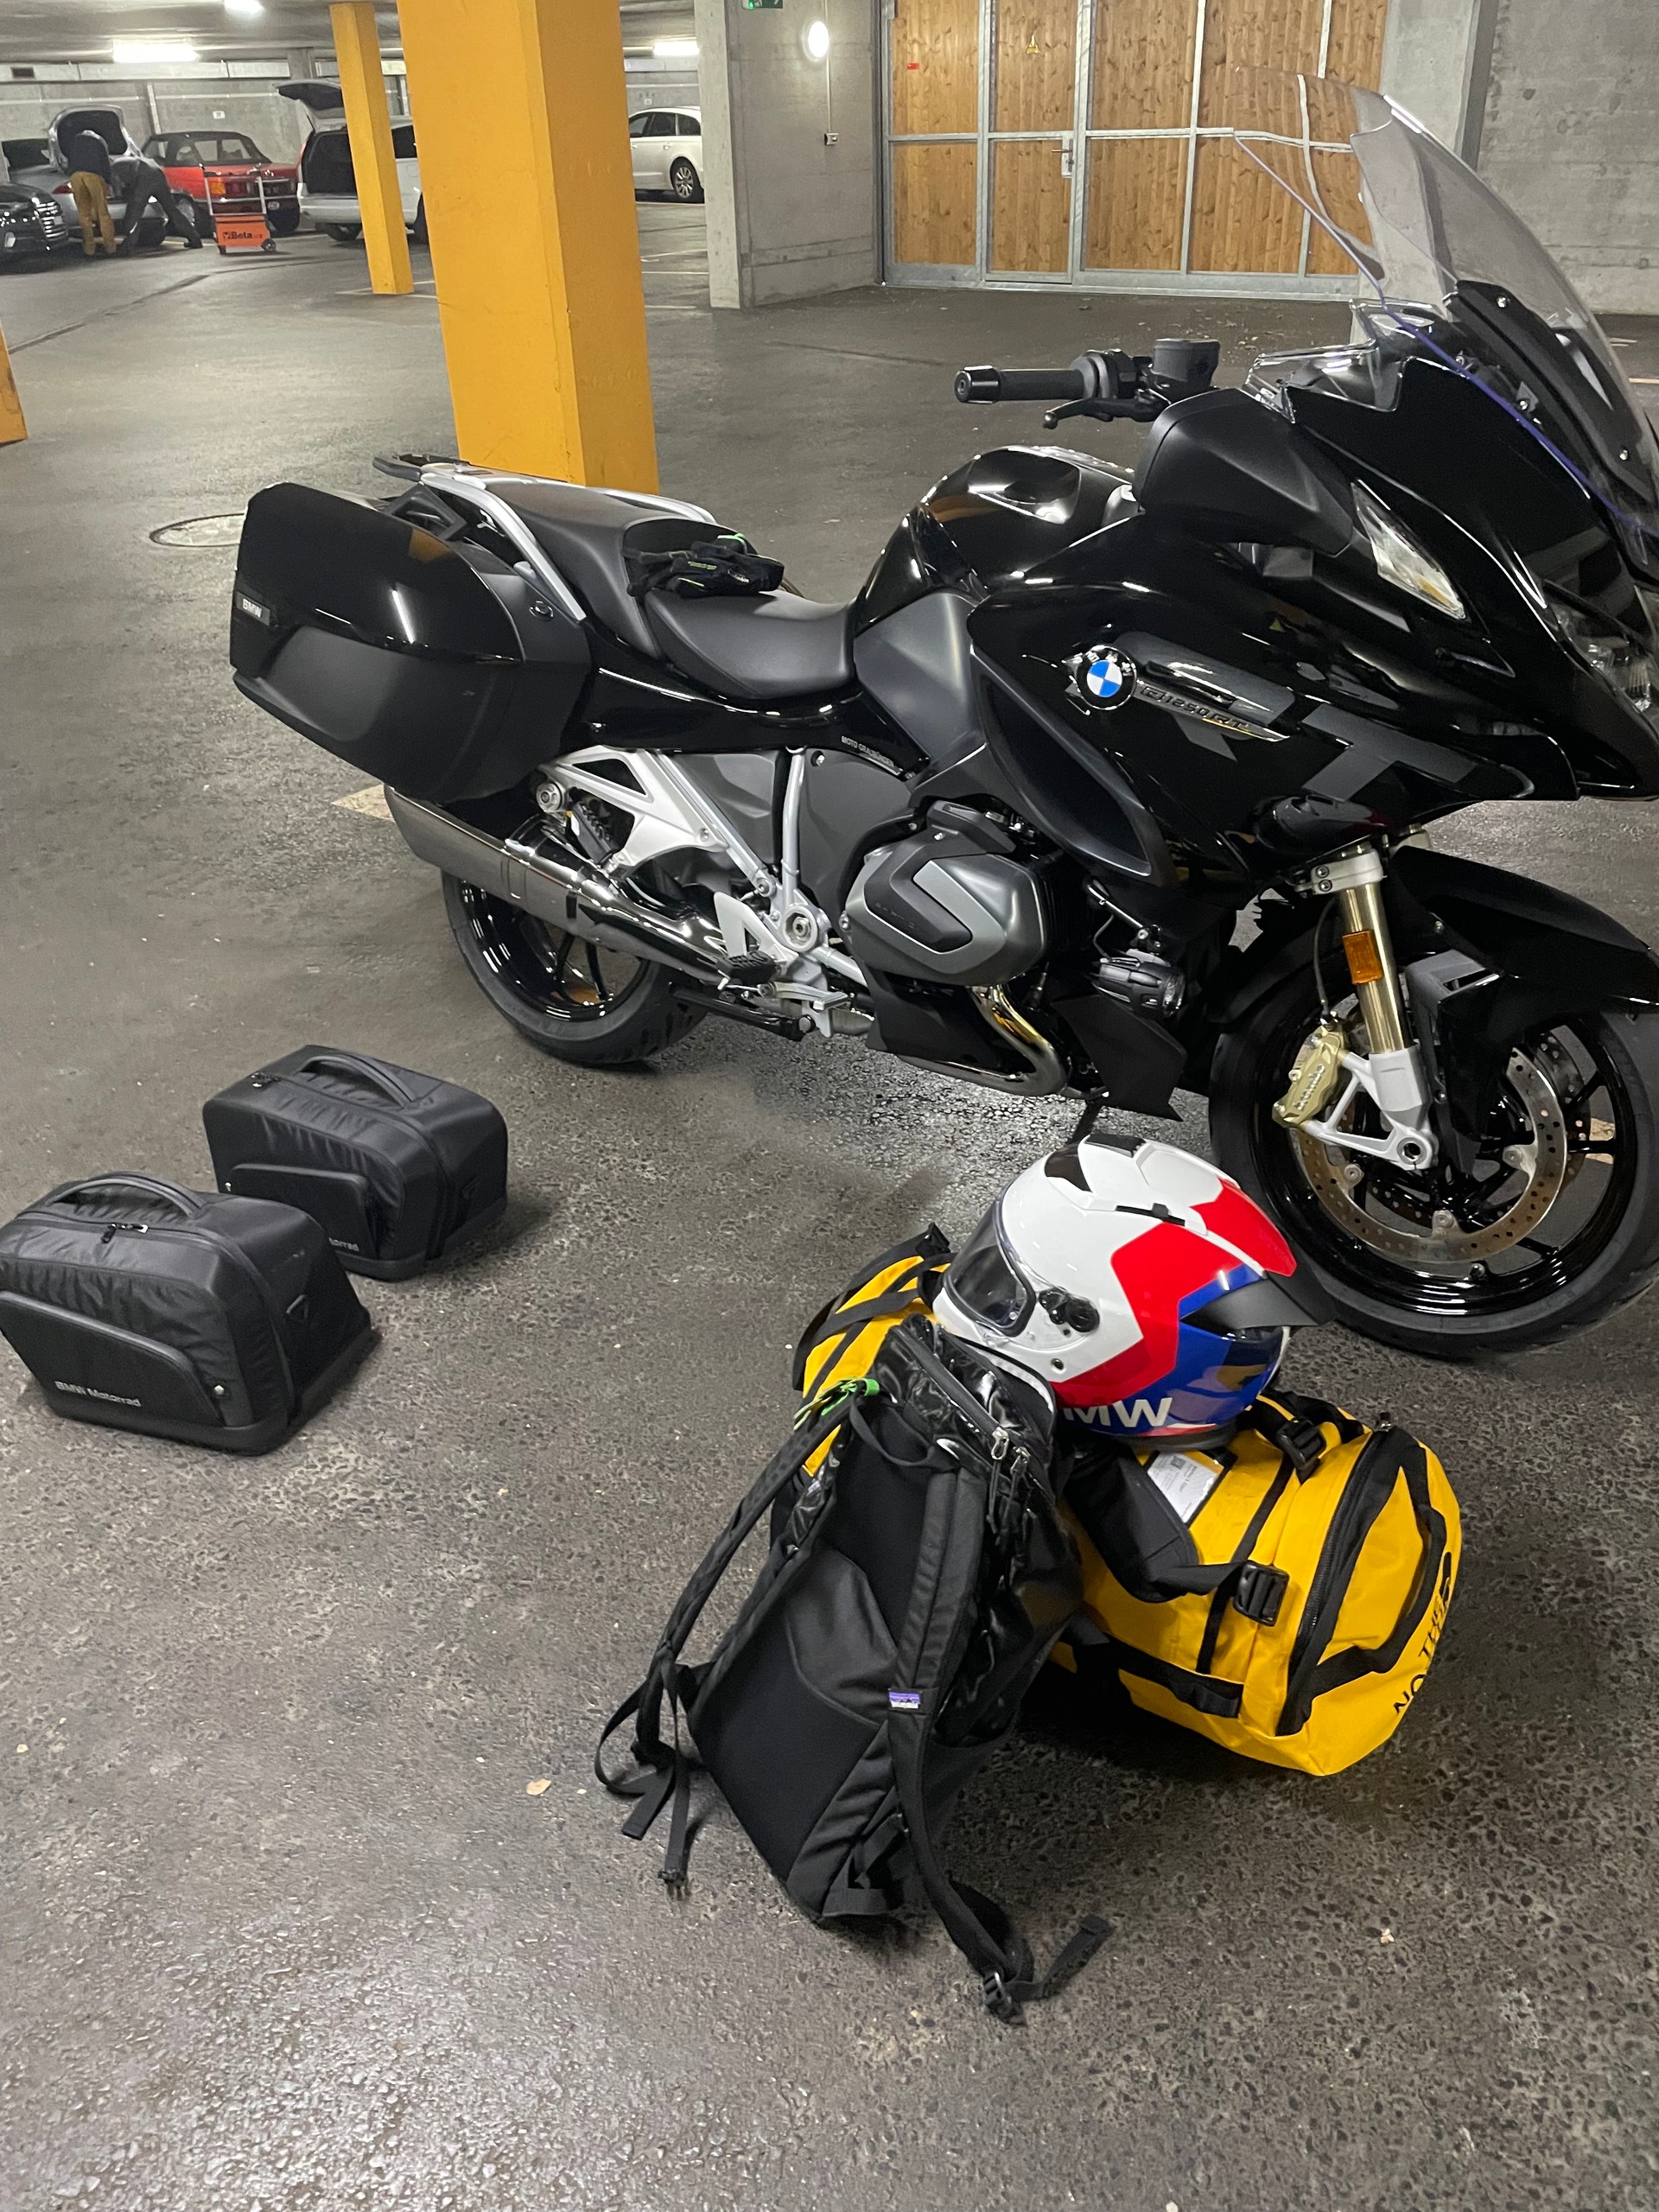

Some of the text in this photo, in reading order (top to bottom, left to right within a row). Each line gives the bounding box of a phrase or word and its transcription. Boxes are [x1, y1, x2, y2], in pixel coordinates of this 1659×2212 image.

[231, 231, 252, 239] Beta
[242, 598, 263, 619] BMW
[841, 735, 858, 749] MOTO
[1292, 1063, 1325, 1111] brembo
[328, 1236, 359, 1252] torrad
[54, 1381, 142, 1407] BMW Motorrad
[1062, 1396, 1173, 1428] MW
